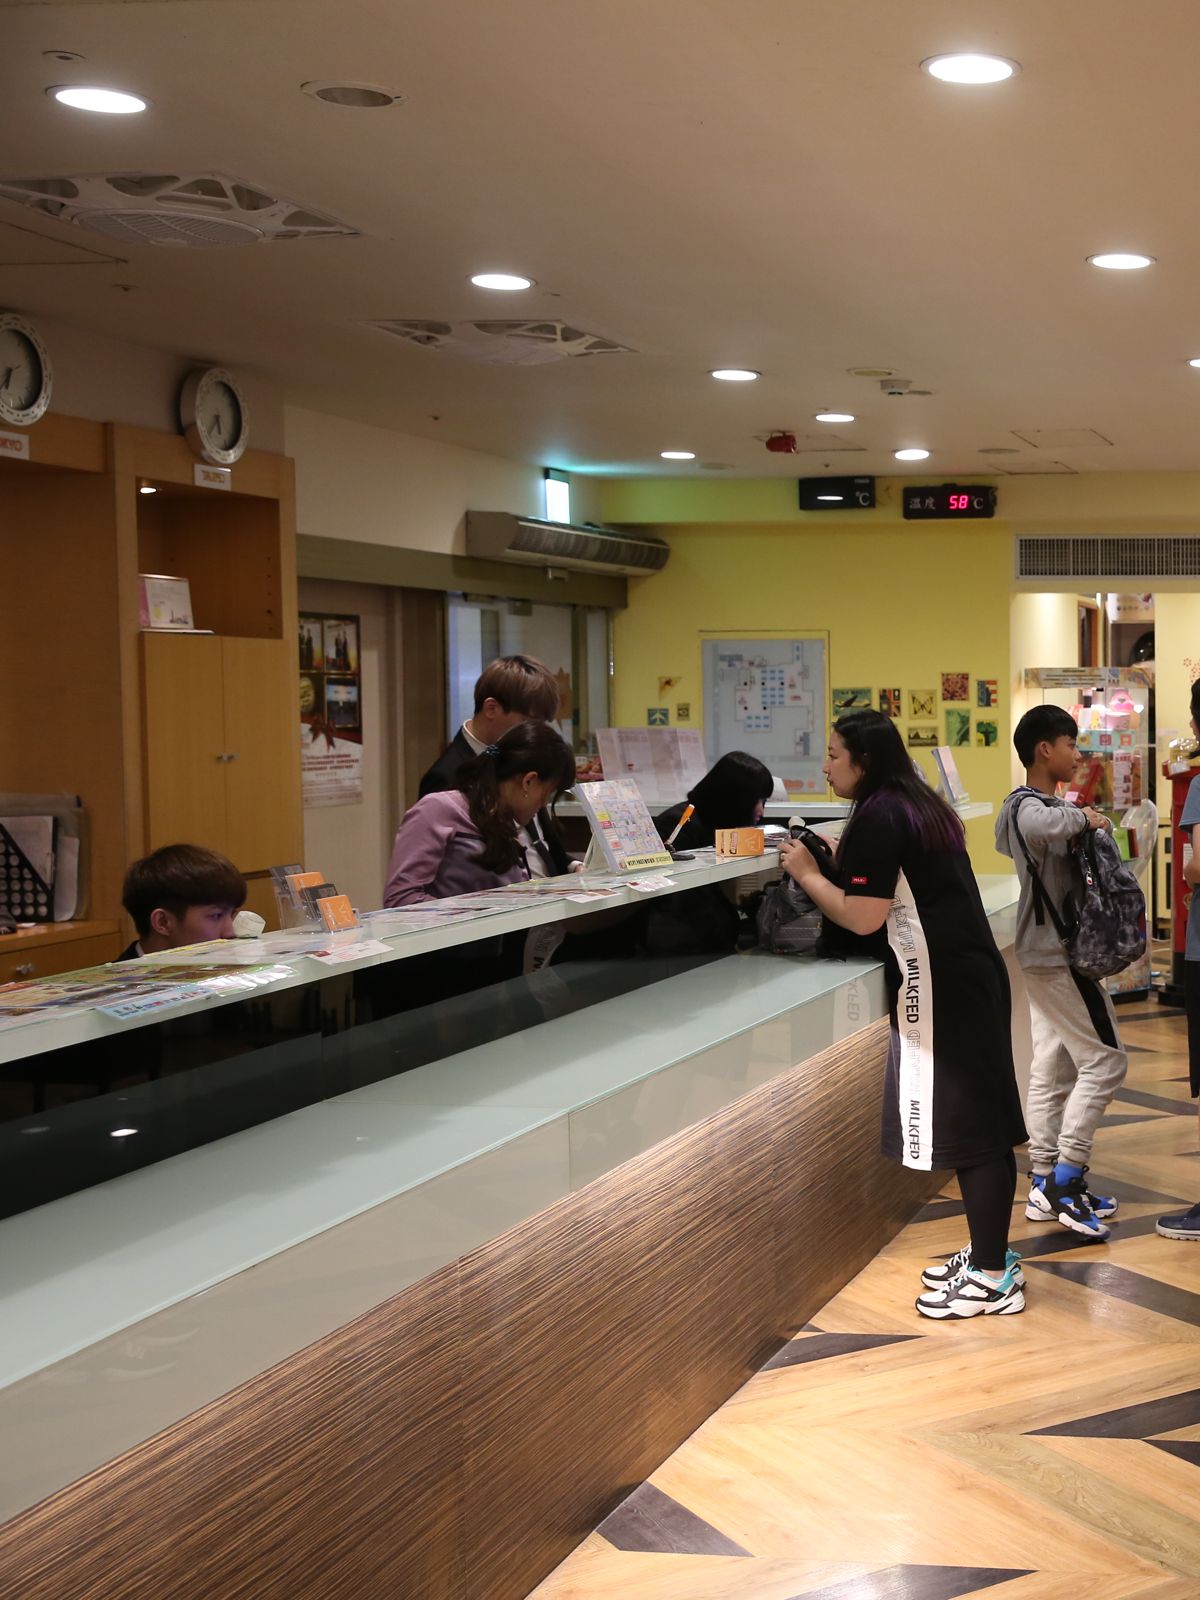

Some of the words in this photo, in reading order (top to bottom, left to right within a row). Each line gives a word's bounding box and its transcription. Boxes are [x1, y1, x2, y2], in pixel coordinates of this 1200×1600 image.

[949, 495, 968, 509] 58
[891, 895, 917, 953] MILKFD
[905, 958, 920, 1024] MILKFED
[909, 1100, 920, 1160] MILKFED
